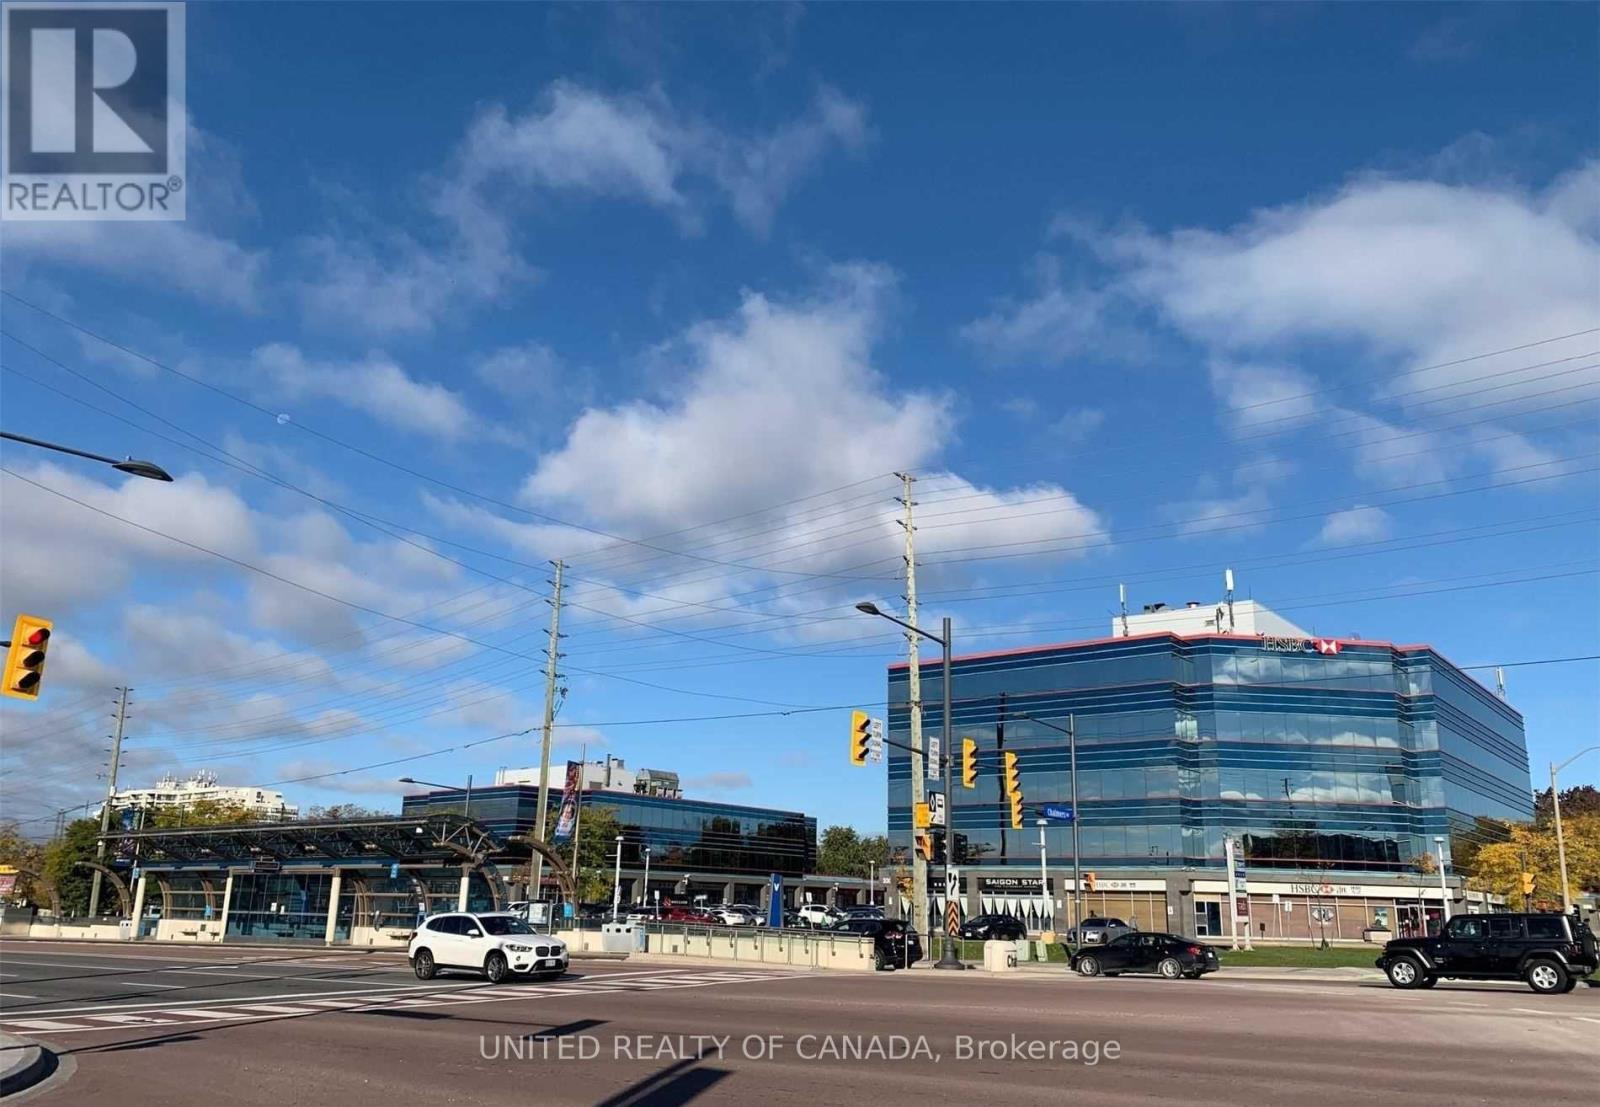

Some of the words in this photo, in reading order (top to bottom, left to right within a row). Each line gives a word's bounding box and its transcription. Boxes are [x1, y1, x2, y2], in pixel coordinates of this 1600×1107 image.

[1262, 636, 1313, 653] HSBC
[985, 878, 1018, 886] SAIGON
[1290, 884, 1319, 894] HSBC
